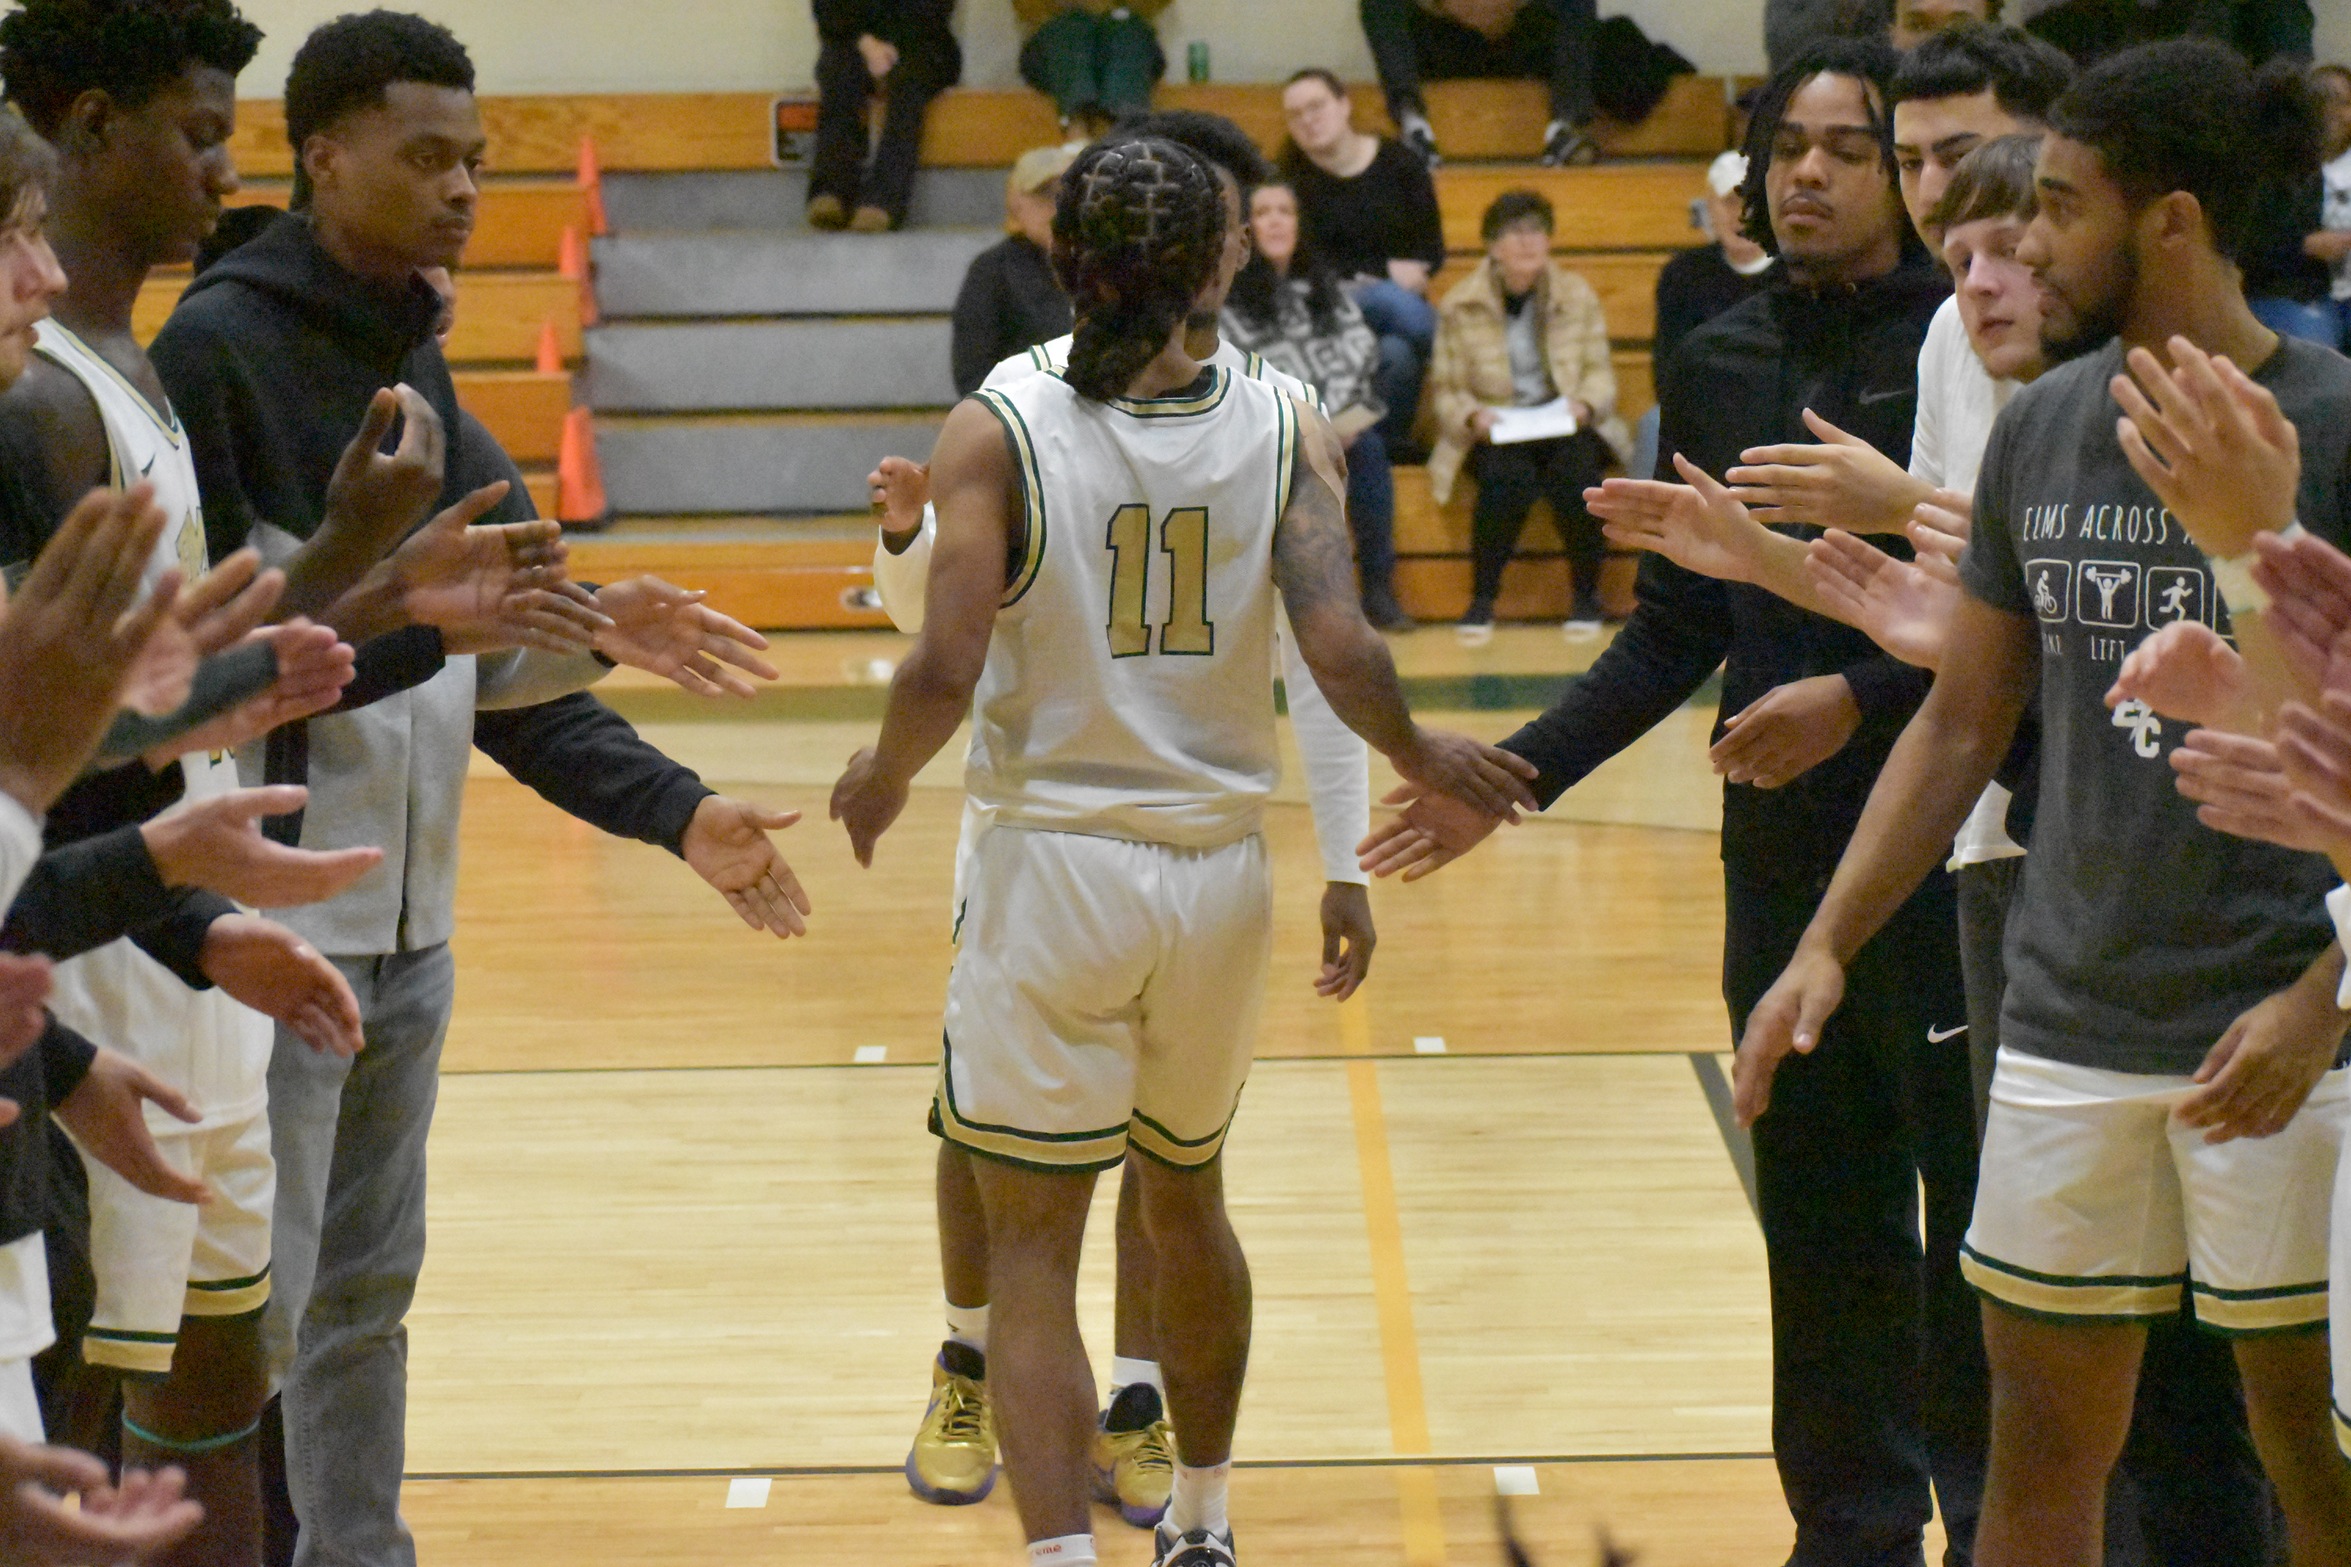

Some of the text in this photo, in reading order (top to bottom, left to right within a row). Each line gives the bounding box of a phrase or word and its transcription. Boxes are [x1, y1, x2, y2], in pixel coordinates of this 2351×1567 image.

[2079, 504, 2169, 545] ACROSS
[1106, 503, 1214, 659] 11
[2091, 635, 2126, 661] LIFT
